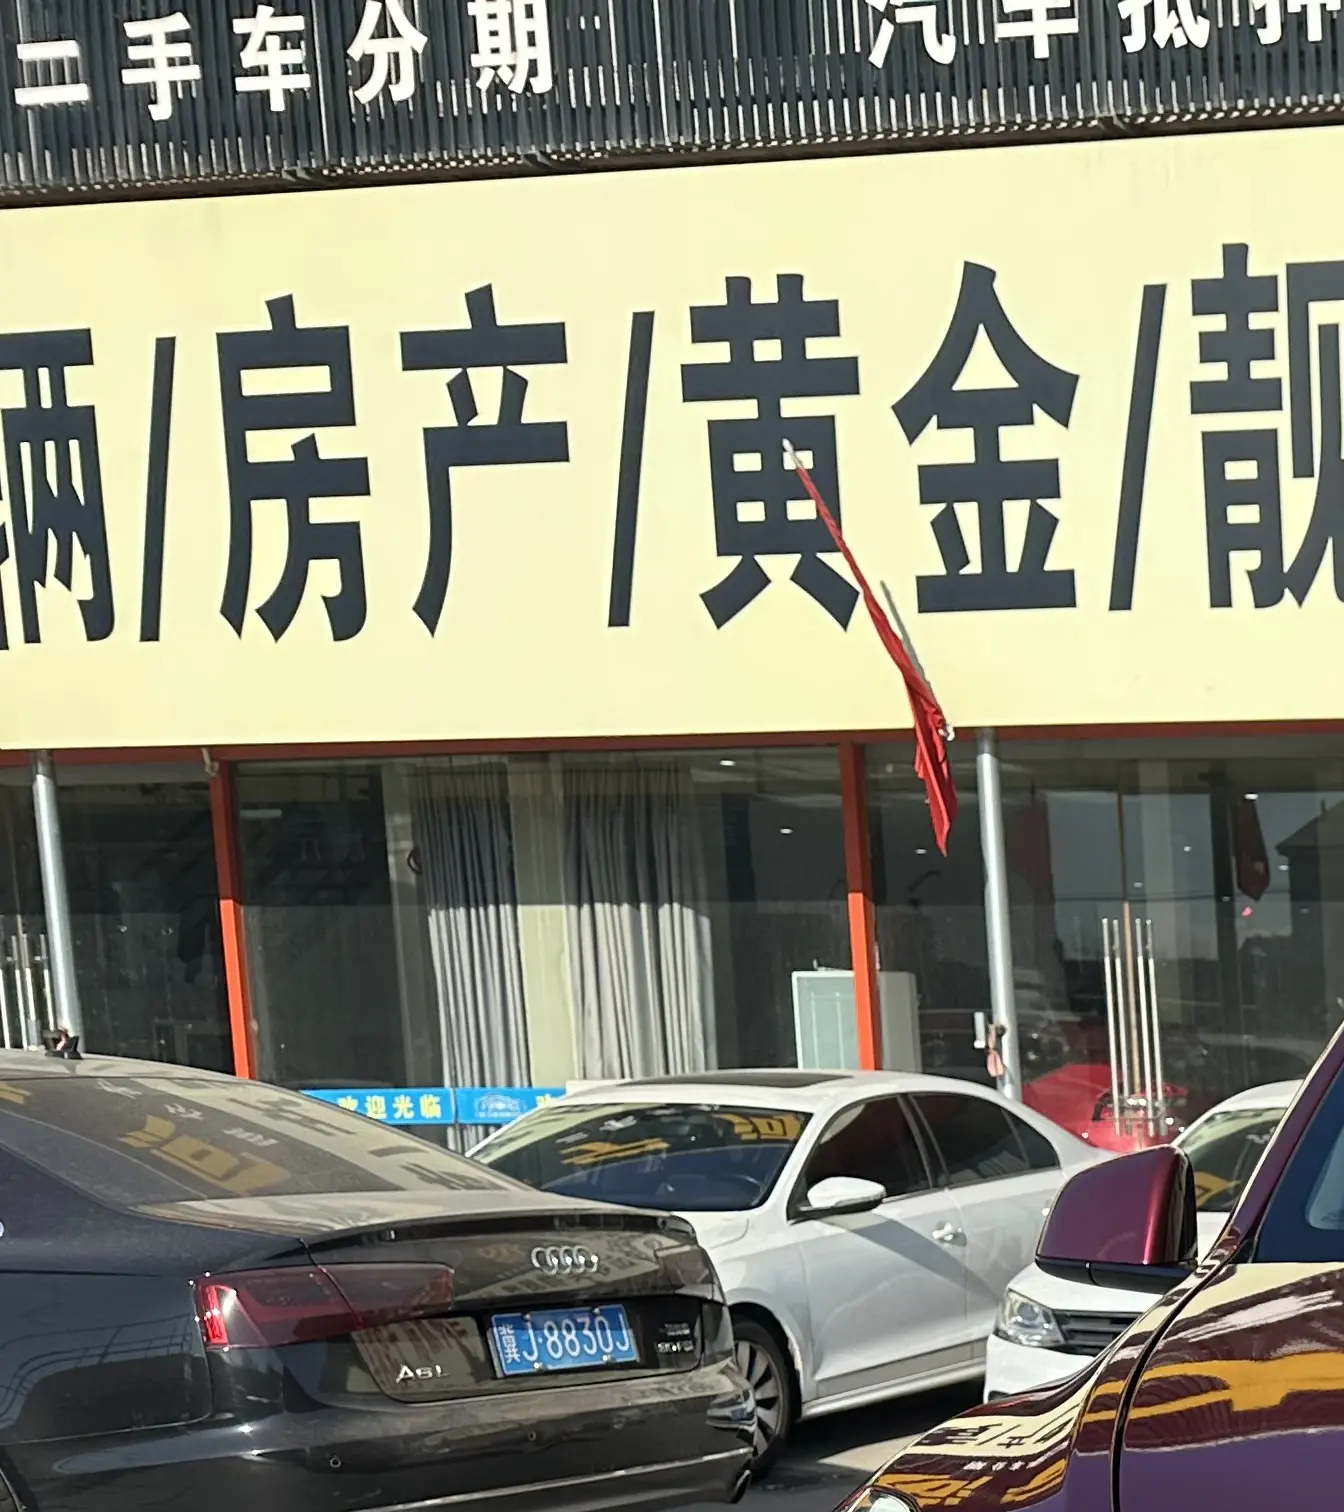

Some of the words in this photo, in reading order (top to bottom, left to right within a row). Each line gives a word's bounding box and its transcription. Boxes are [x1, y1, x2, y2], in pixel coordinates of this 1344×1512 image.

[14, 0, 554, 121] 二手车分期
